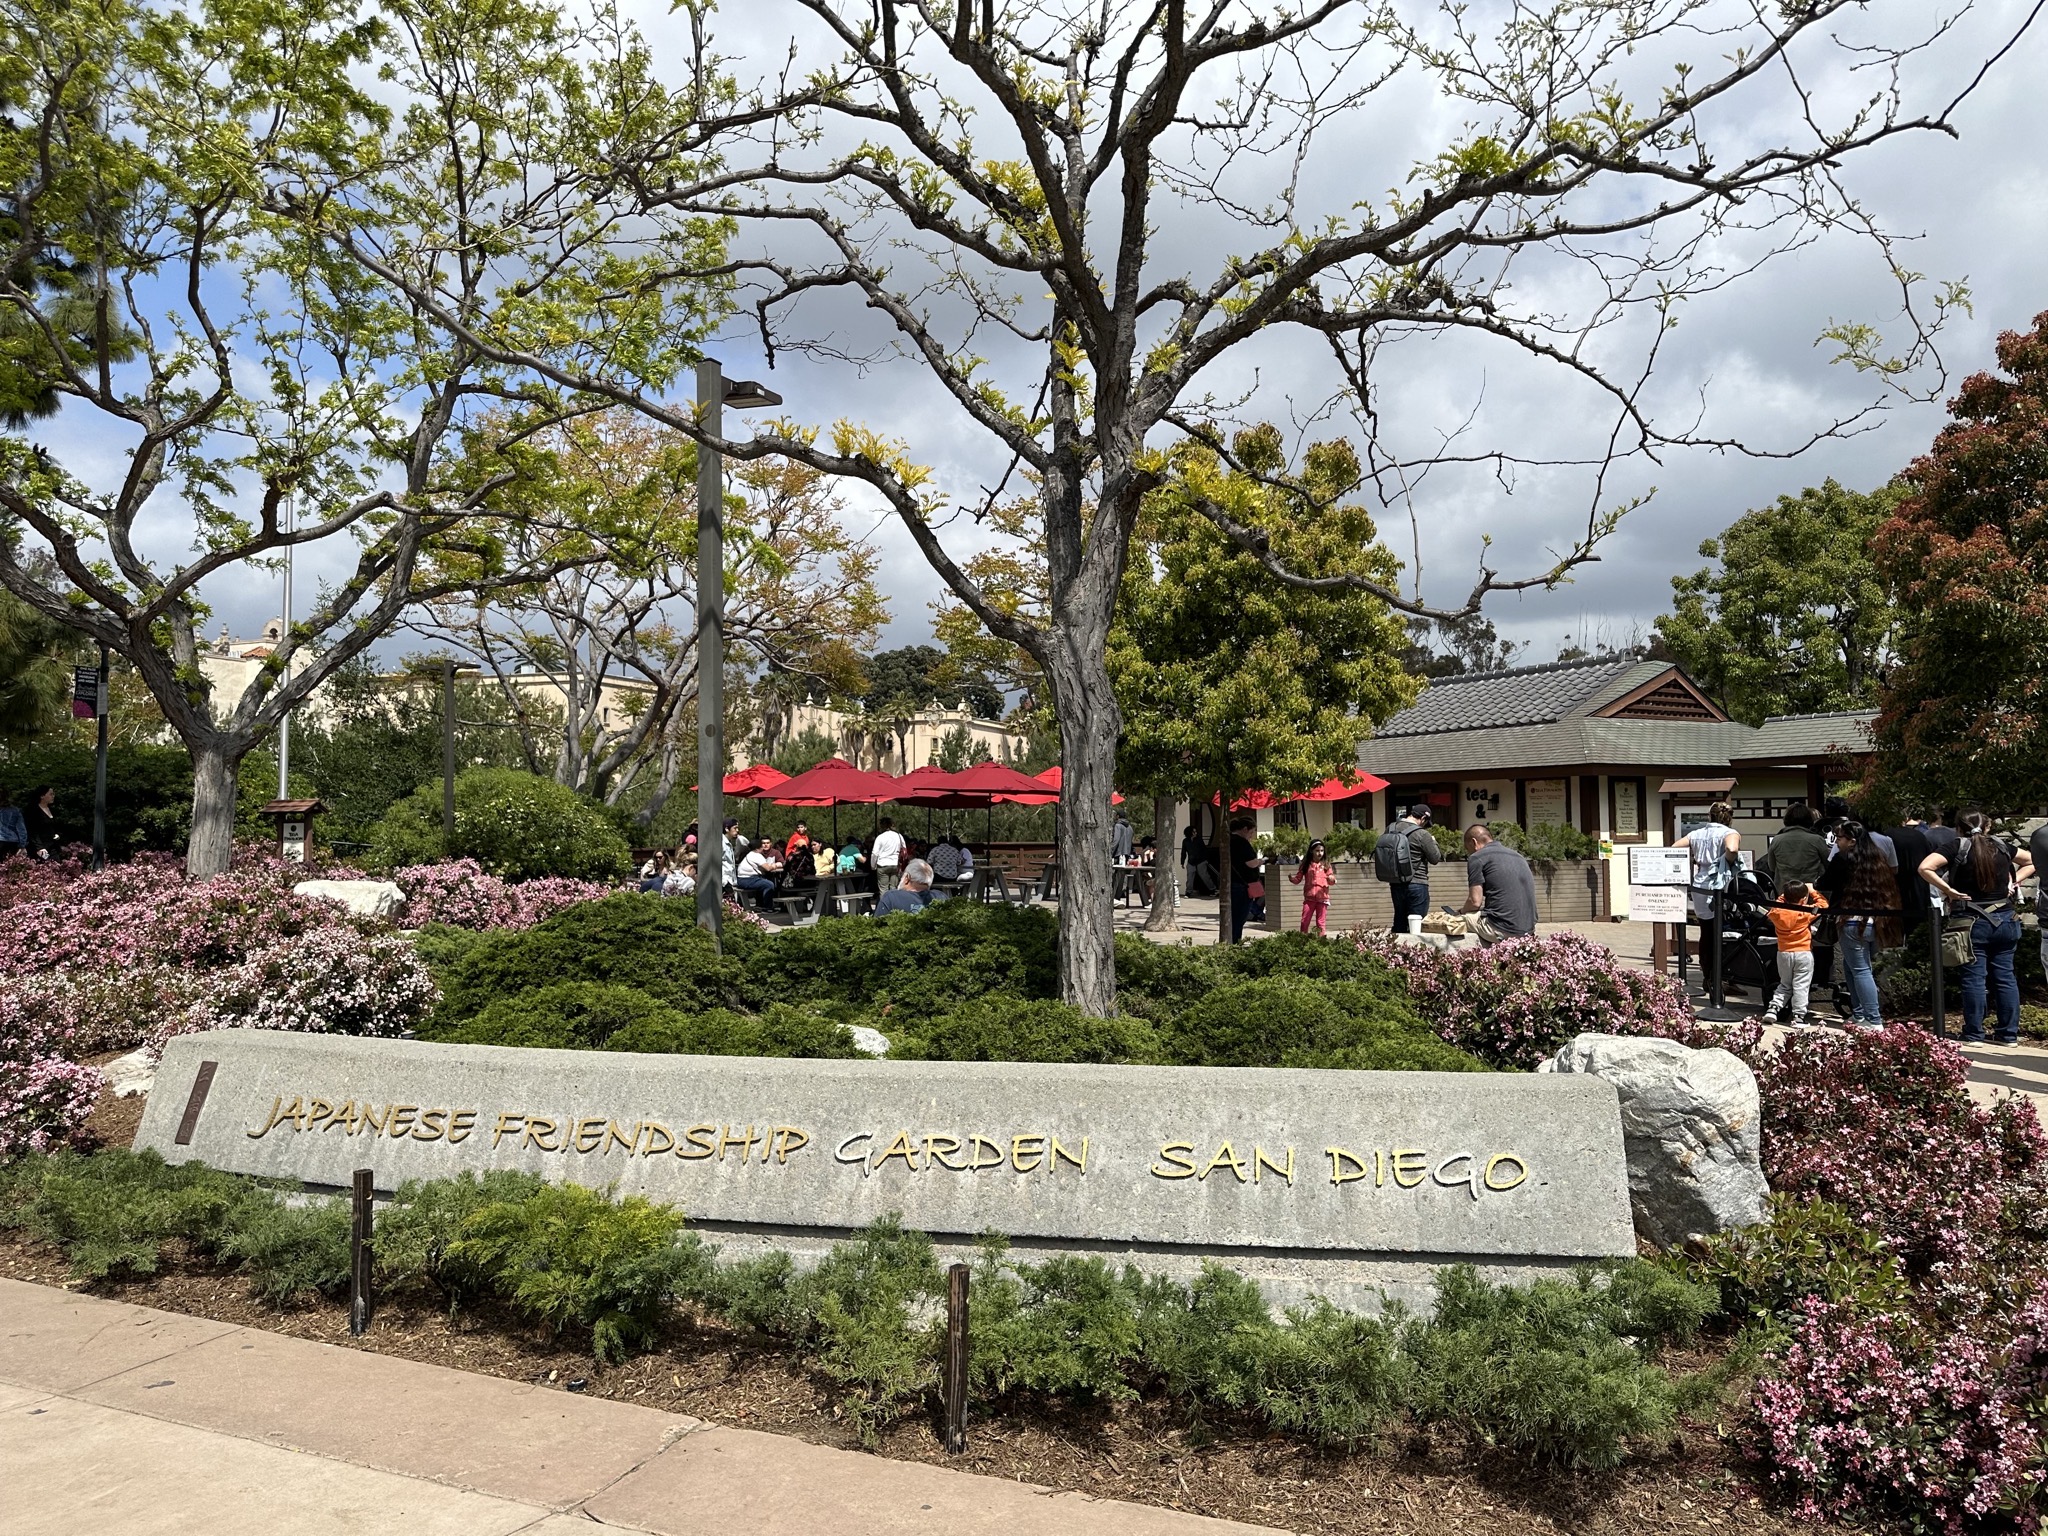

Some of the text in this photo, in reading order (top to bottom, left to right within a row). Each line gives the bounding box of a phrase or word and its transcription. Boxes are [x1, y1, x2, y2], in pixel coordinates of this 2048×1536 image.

[1823, 765, 1850, 775] JAPAN
[1465, 786, 1488, 801] tea
[1476, 803, 1486, 819] &
[247, 1096, 1529, 1200] JAPANESE FRIENDSHIP GARDEN SAN DIEGO
